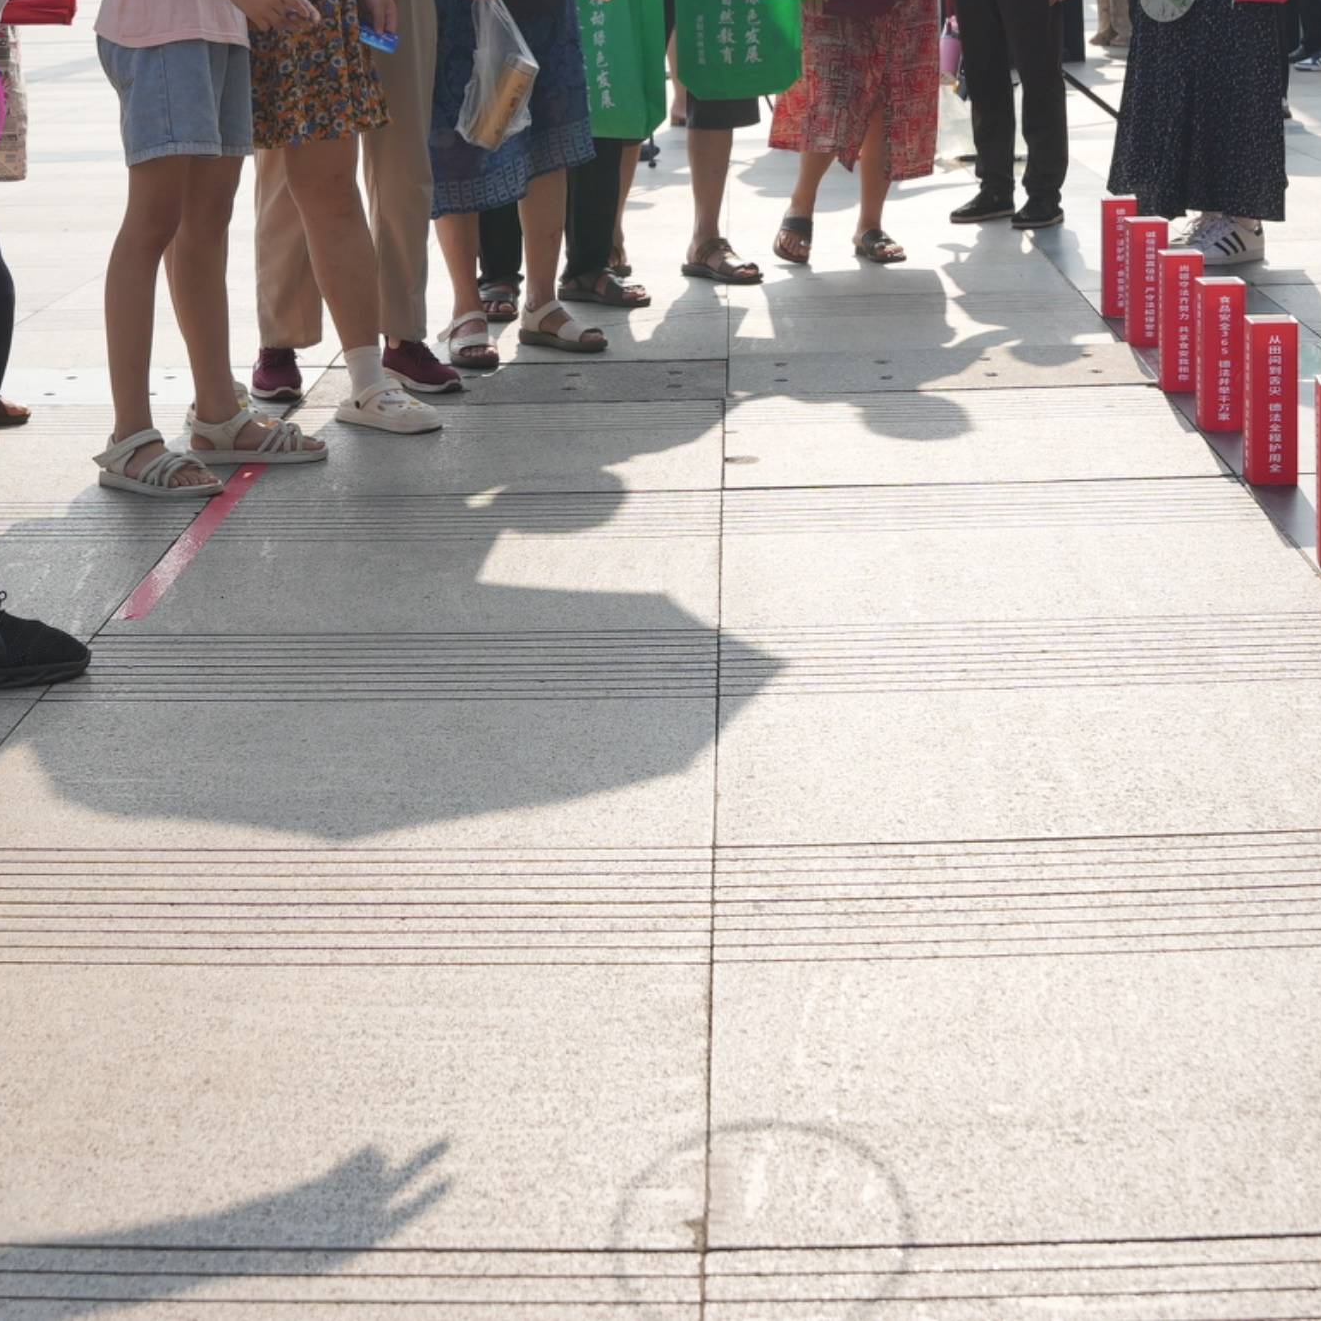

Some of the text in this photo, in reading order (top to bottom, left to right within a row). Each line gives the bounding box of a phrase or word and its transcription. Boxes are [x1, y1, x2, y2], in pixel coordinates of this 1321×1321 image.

[1268, 334, 1282, 396] 从田间到舌尖
